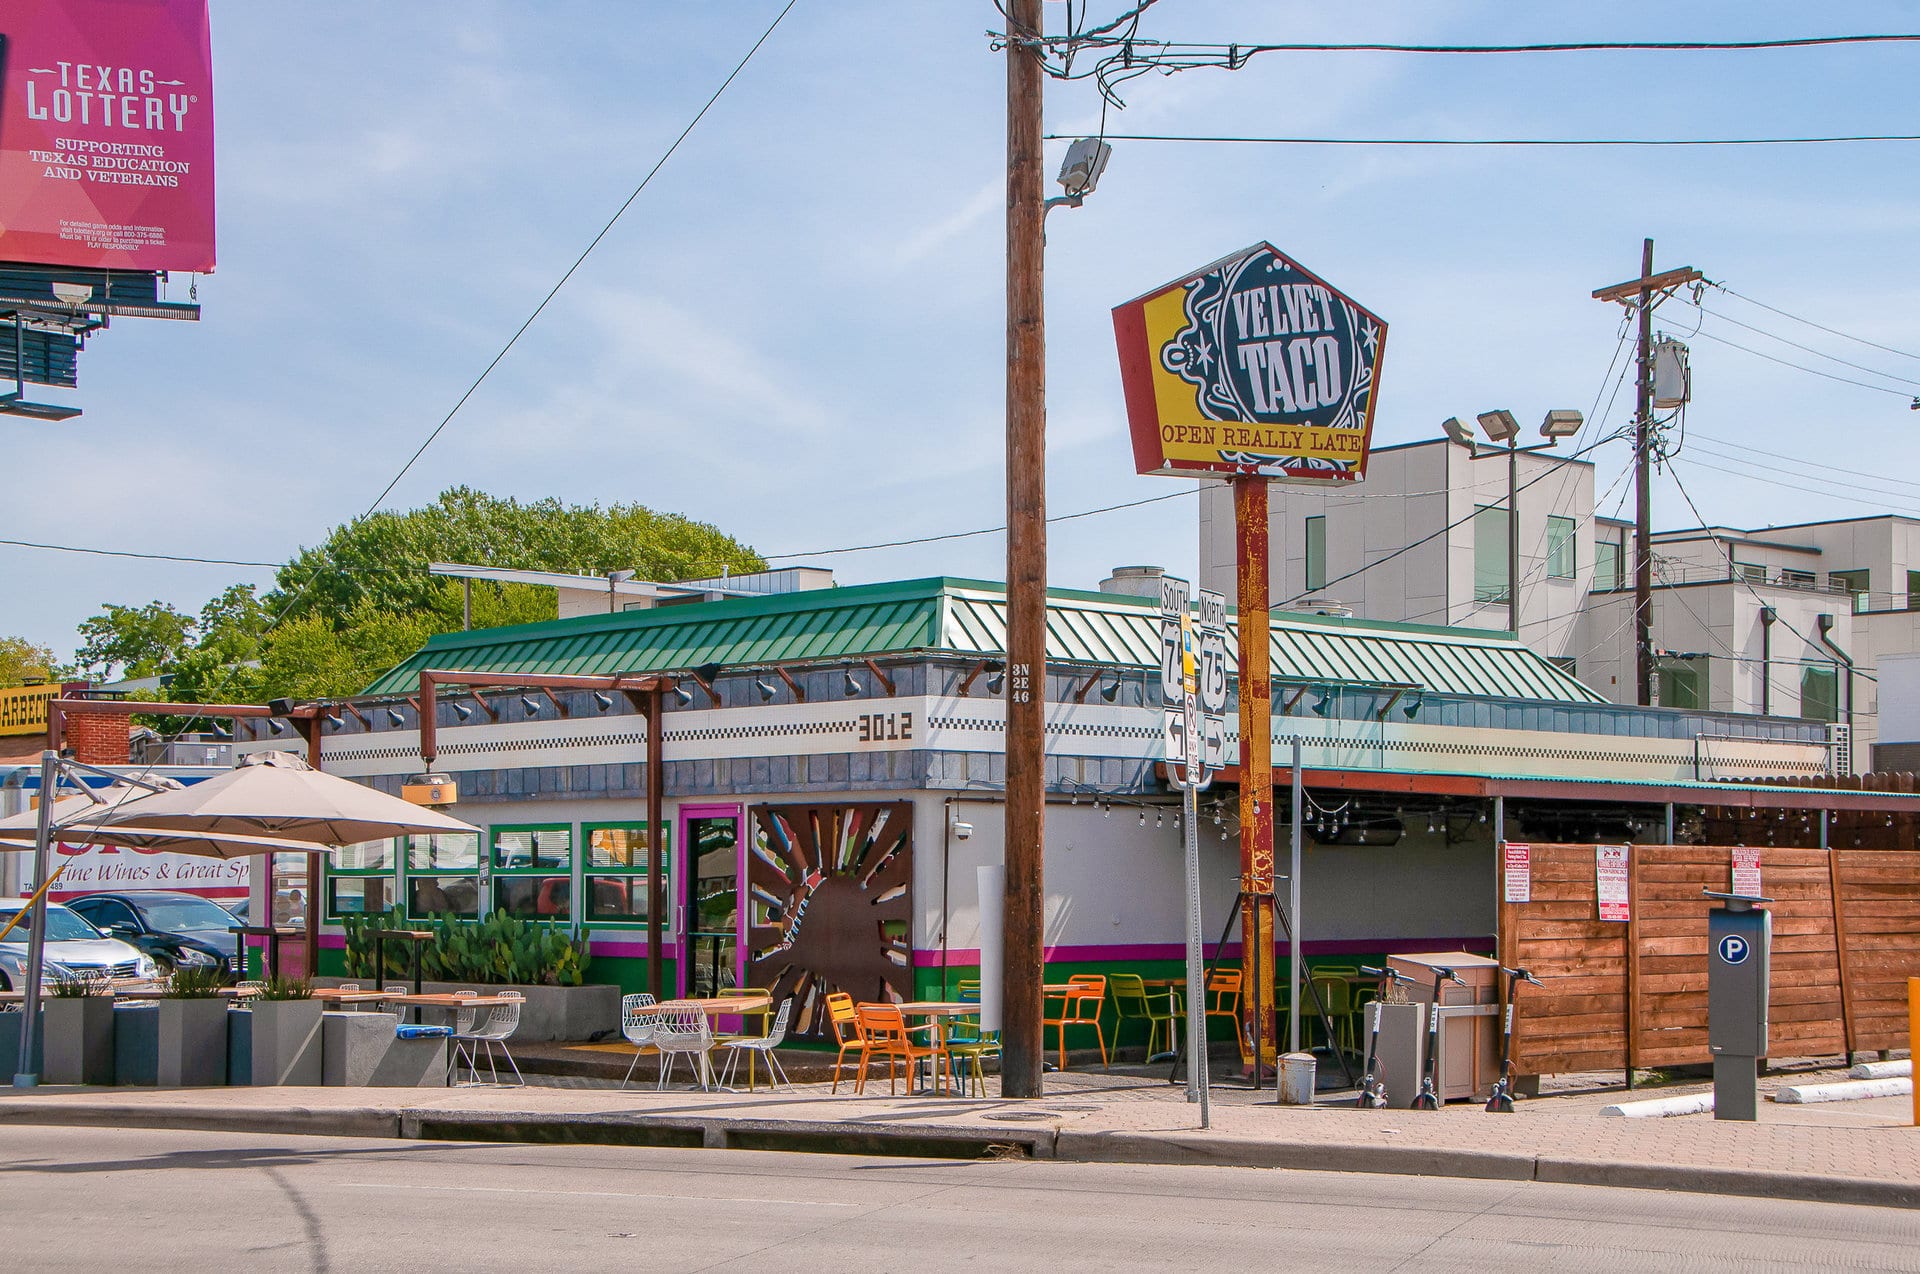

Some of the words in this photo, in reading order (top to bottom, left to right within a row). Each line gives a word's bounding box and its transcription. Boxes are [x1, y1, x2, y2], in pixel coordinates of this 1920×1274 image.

[57, 61, 154, 95] TEXAS
[29, 149, 88, 167] TEXAS
[91, 156, 191, 174] EDUCATION
[55, 137, 165, 158] SUPPORTING
[43, 166, 82, 181] AND
[85, 169, 179, 188] VETERANS
[1231, 284, 1335, 340] VELVET
[1236, 335, 1343, 414] TACO
[1161, 424, 1216, 444] OPEN
[1222, 427, 1304, 450] REALLY
[1309, 432, 1364, 453] LATE
[1163, 583, 1188, 614] SOUTH
[1200, 596, 1225, 626] NORTH
[1012, 663, 1030, 676] 3N
[1012, 677, 1029, 689] 2E
[1203, 650, 1224, 695] 75
[0, 692, 58, 727] ARBECU
[1012, 690, 1030, 703] 46
[859, 712, 913, 742] 3012
[57, 863, 93, 882] Fine
[98, 863, 151, 881] Wines
[156, 862, 171, 880] &
[176, 862, 224, 880] Great
[227, 861, 250, 885] Sp
[1726, 939, 1742, 959] P
